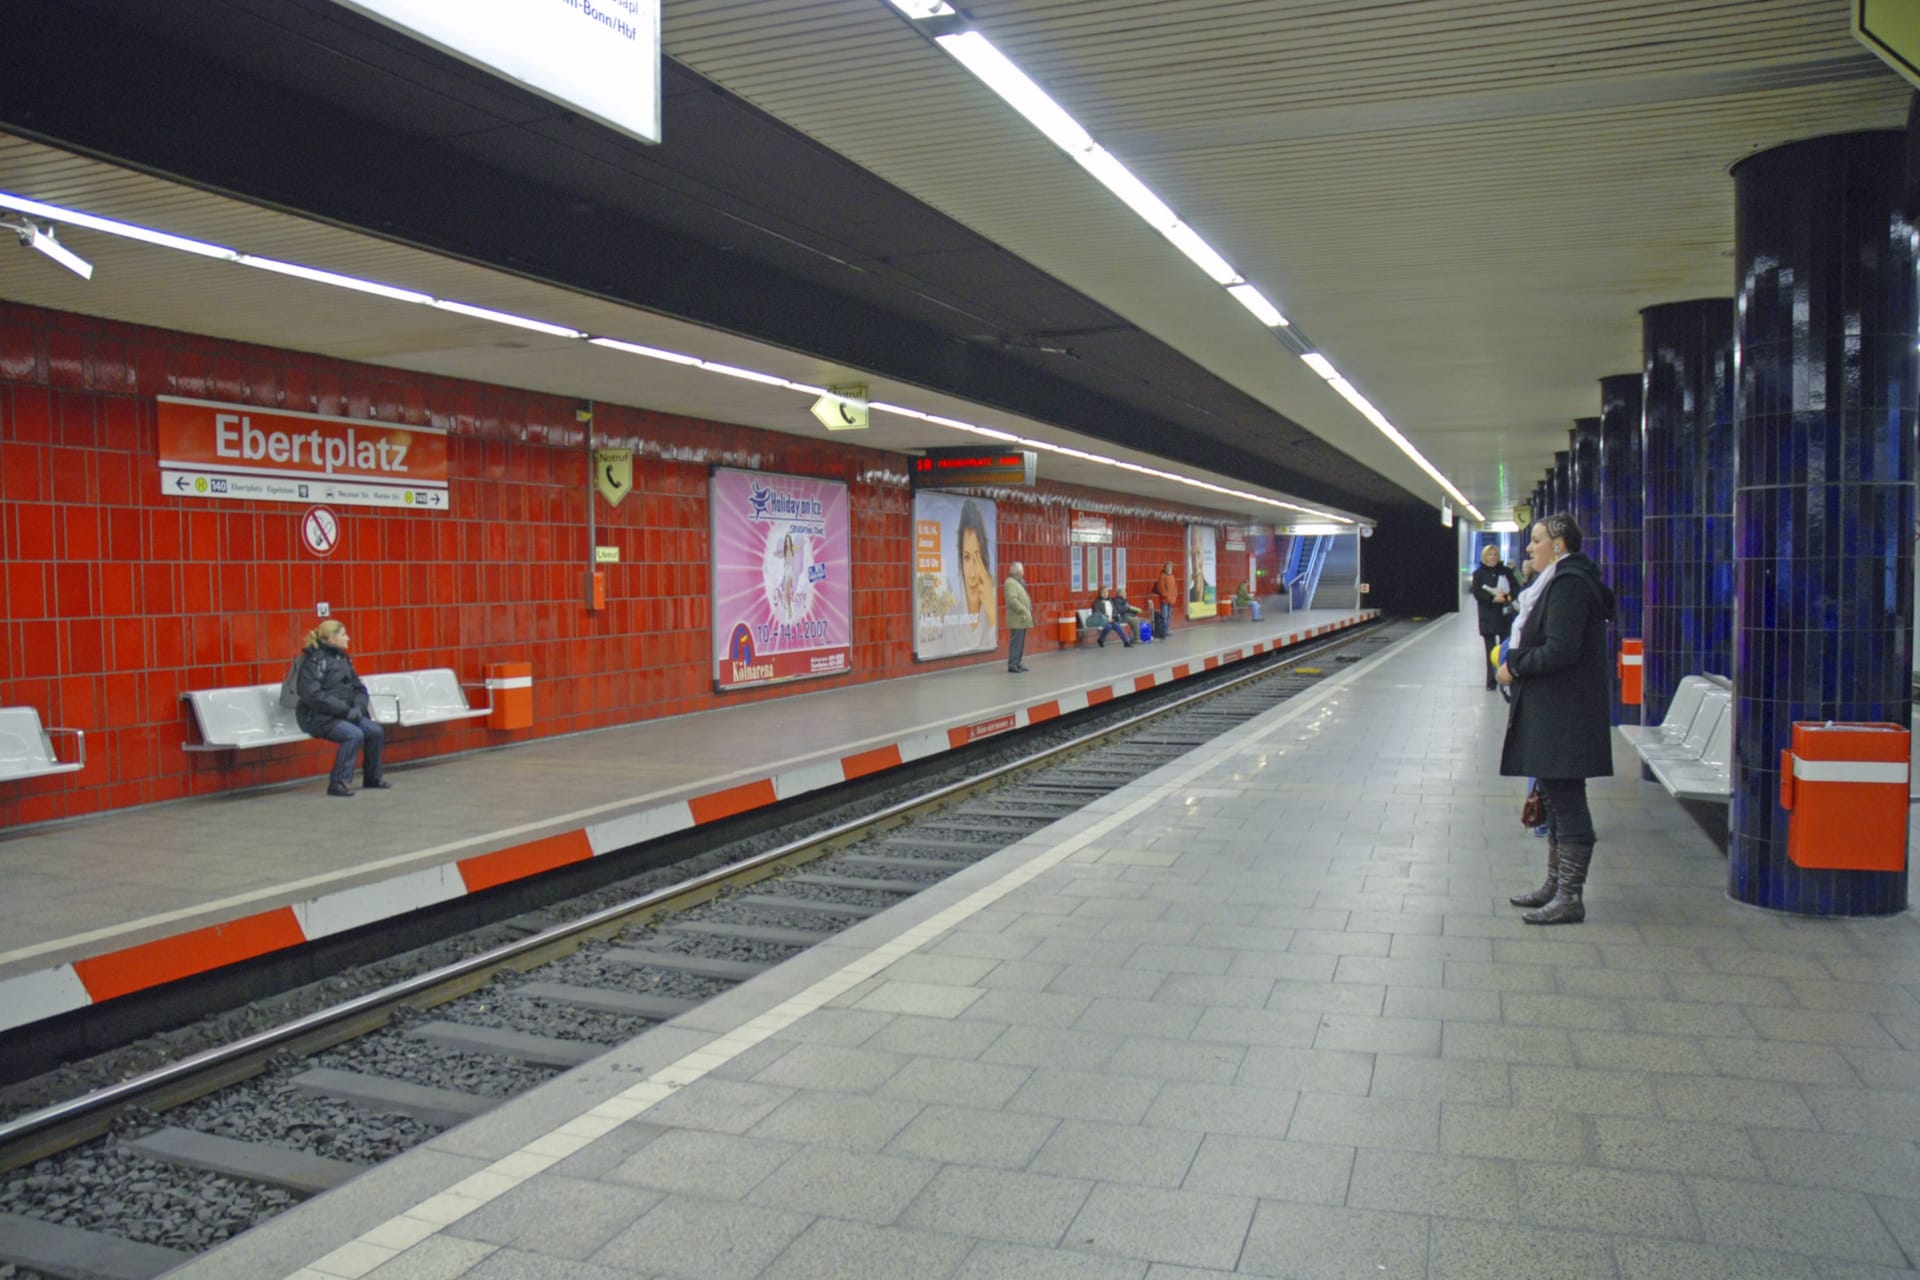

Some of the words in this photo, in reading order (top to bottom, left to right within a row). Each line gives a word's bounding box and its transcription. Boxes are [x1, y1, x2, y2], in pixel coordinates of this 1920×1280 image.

[215, 413, 409, 473] Ebertplatz
[600, 453, 628, 462] Notruf
[211, 479, 227, 493] 140
[770, 490, 799, 519] Holiday
[801, 501, 811, 514] on
[811, 496, 822, 515] Ice
[732, 660, 775, 682] Kölnarena
